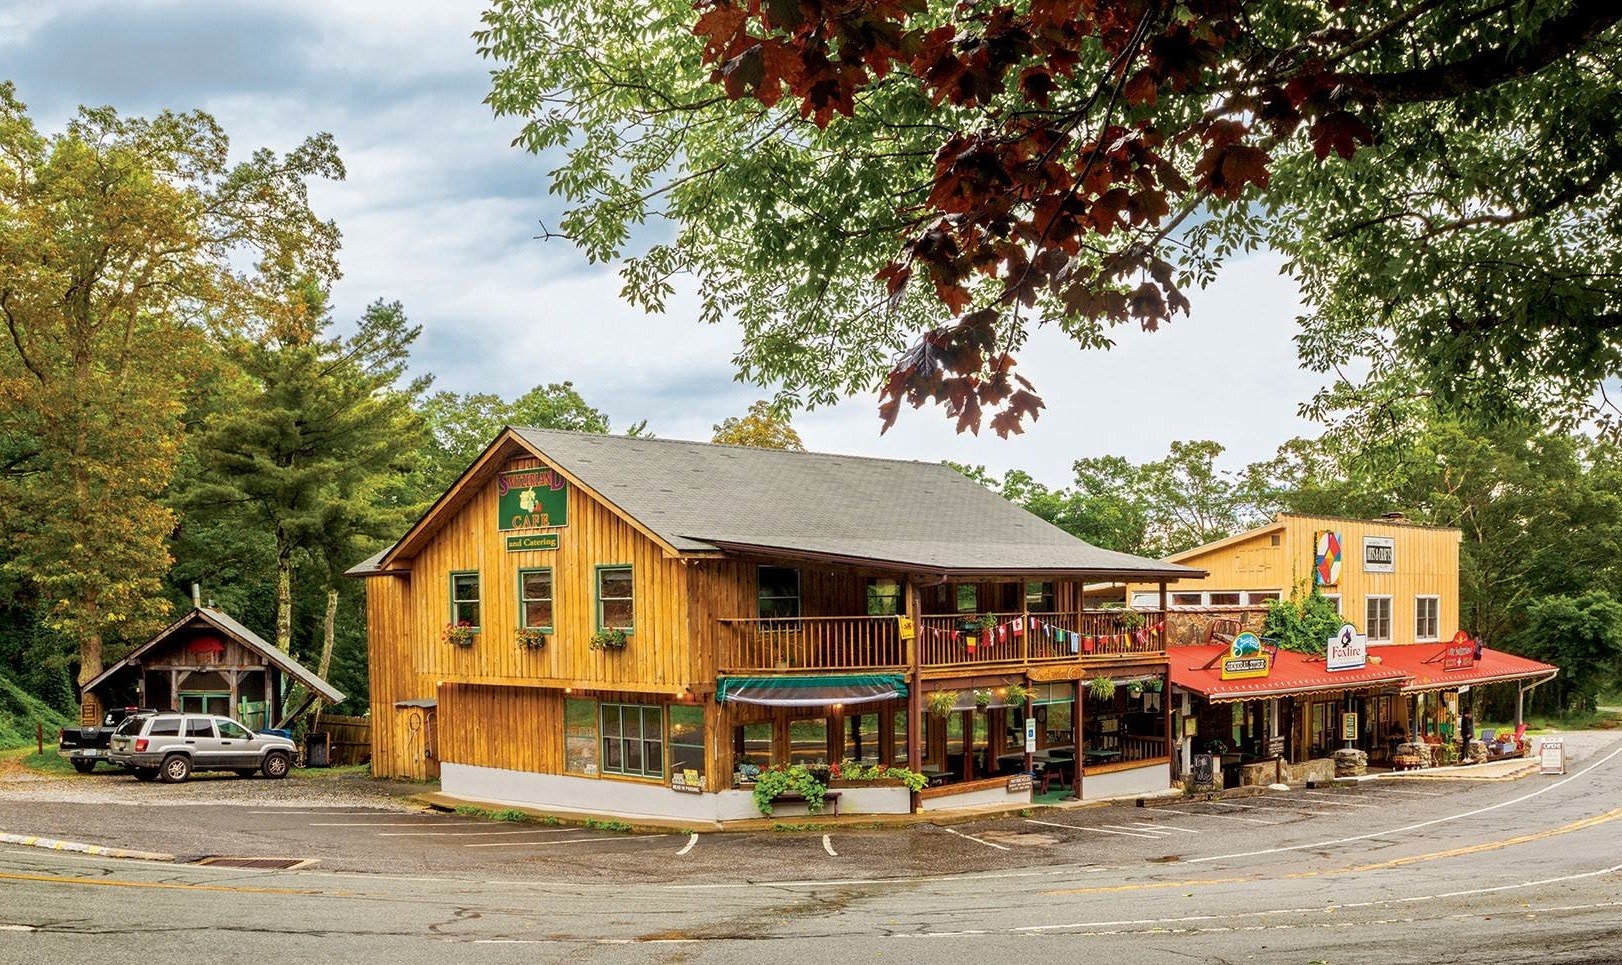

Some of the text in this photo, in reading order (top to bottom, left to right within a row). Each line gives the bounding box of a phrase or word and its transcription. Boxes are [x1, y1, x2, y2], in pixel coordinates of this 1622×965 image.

[512, 514, 550, 528] CAFE
[509, 536, 556, 548] and Catering
[1332, 645, 1360, 659] Foxfire
